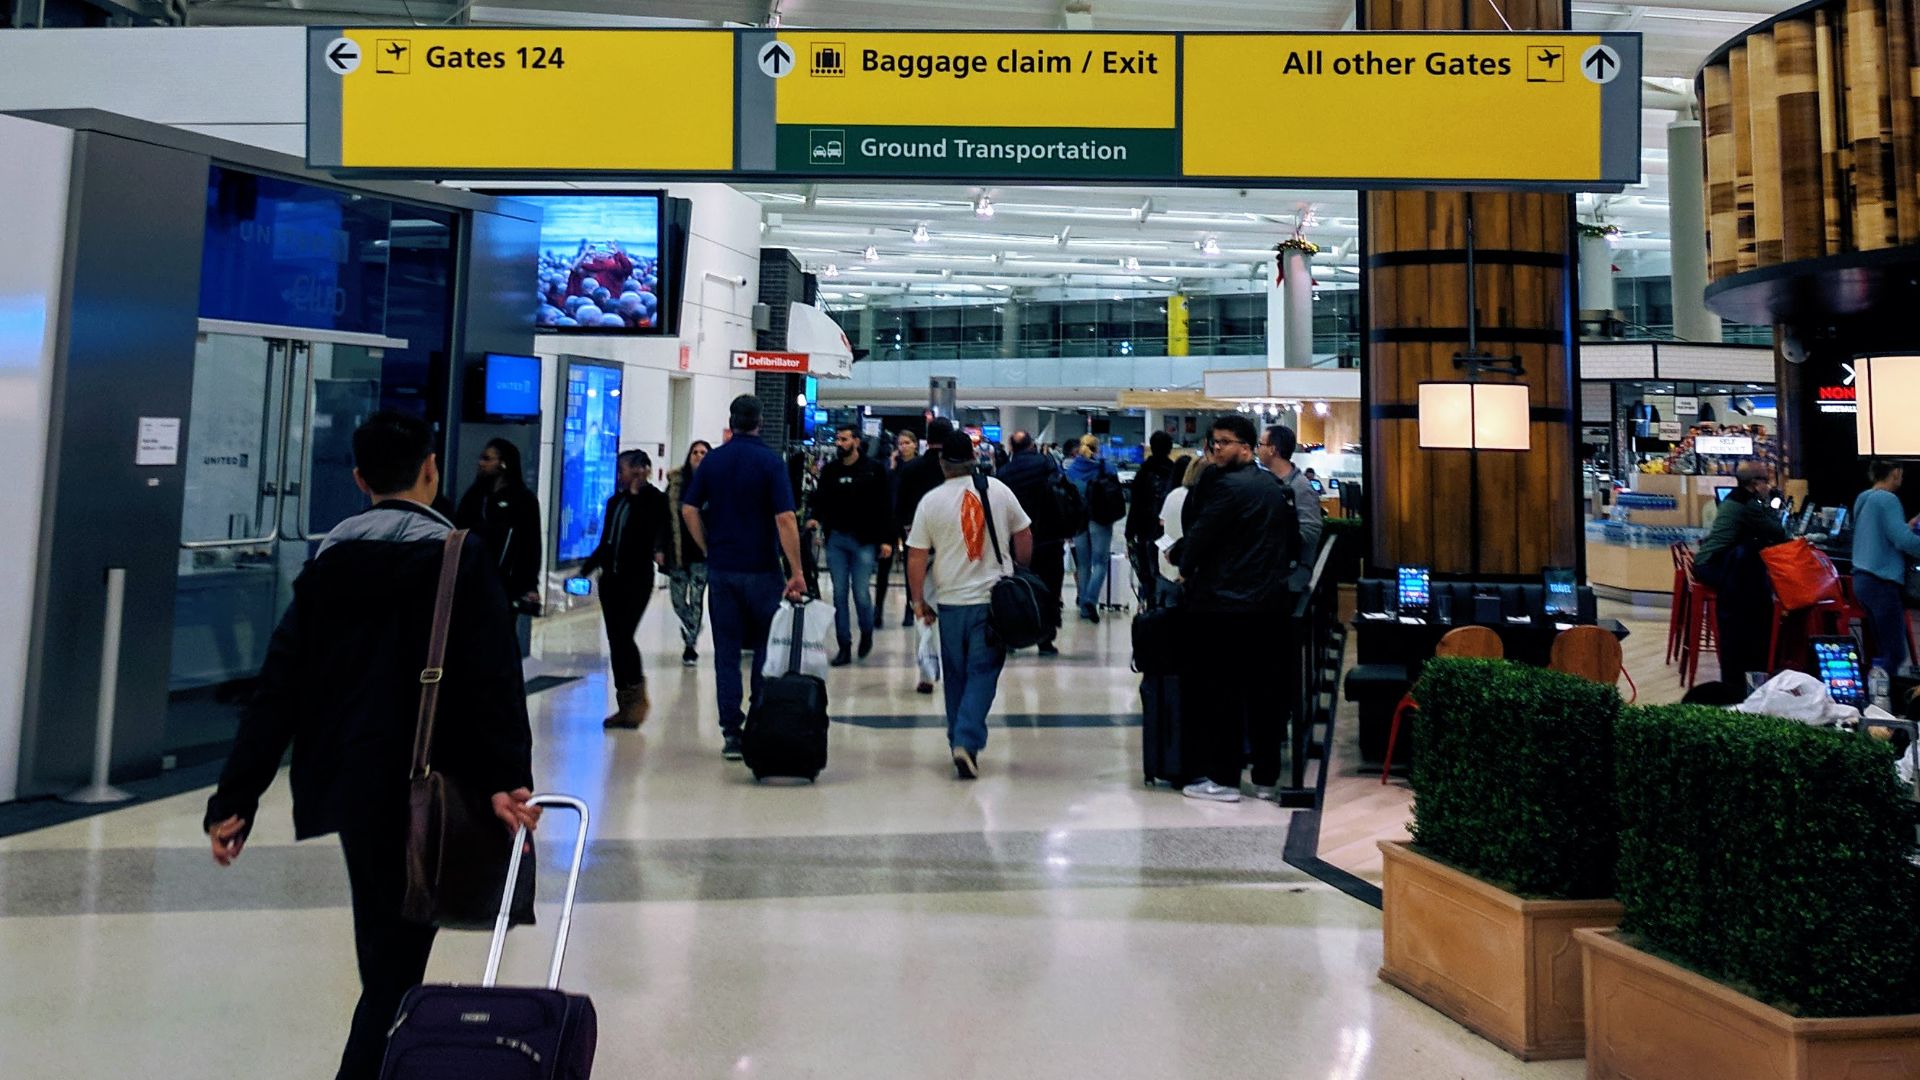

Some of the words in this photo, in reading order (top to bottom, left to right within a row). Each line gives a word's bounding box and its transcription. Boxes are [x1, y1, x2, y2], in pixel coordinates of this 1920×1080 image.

[426, 45, 506, 70] Gates
[516, 46, 565, 69] 124
[861, 48, 988, 79] Baggage
[996, 48, 1072, 74] claim
[1081, 50, 1093, 74] /
[1103, 50, 1159, 75] Exit
[1283, 50, 1323, 75] All
[1332, 51, 1416, 76] other
[1424, 52, 1511, 76] Gates
[859, 137, 947, 159] Ground
[953, 138, 1128, 164] Transportation
[748, 355, 800, 368] Defibrillator
[203, 455, 238, 465] UNITED
